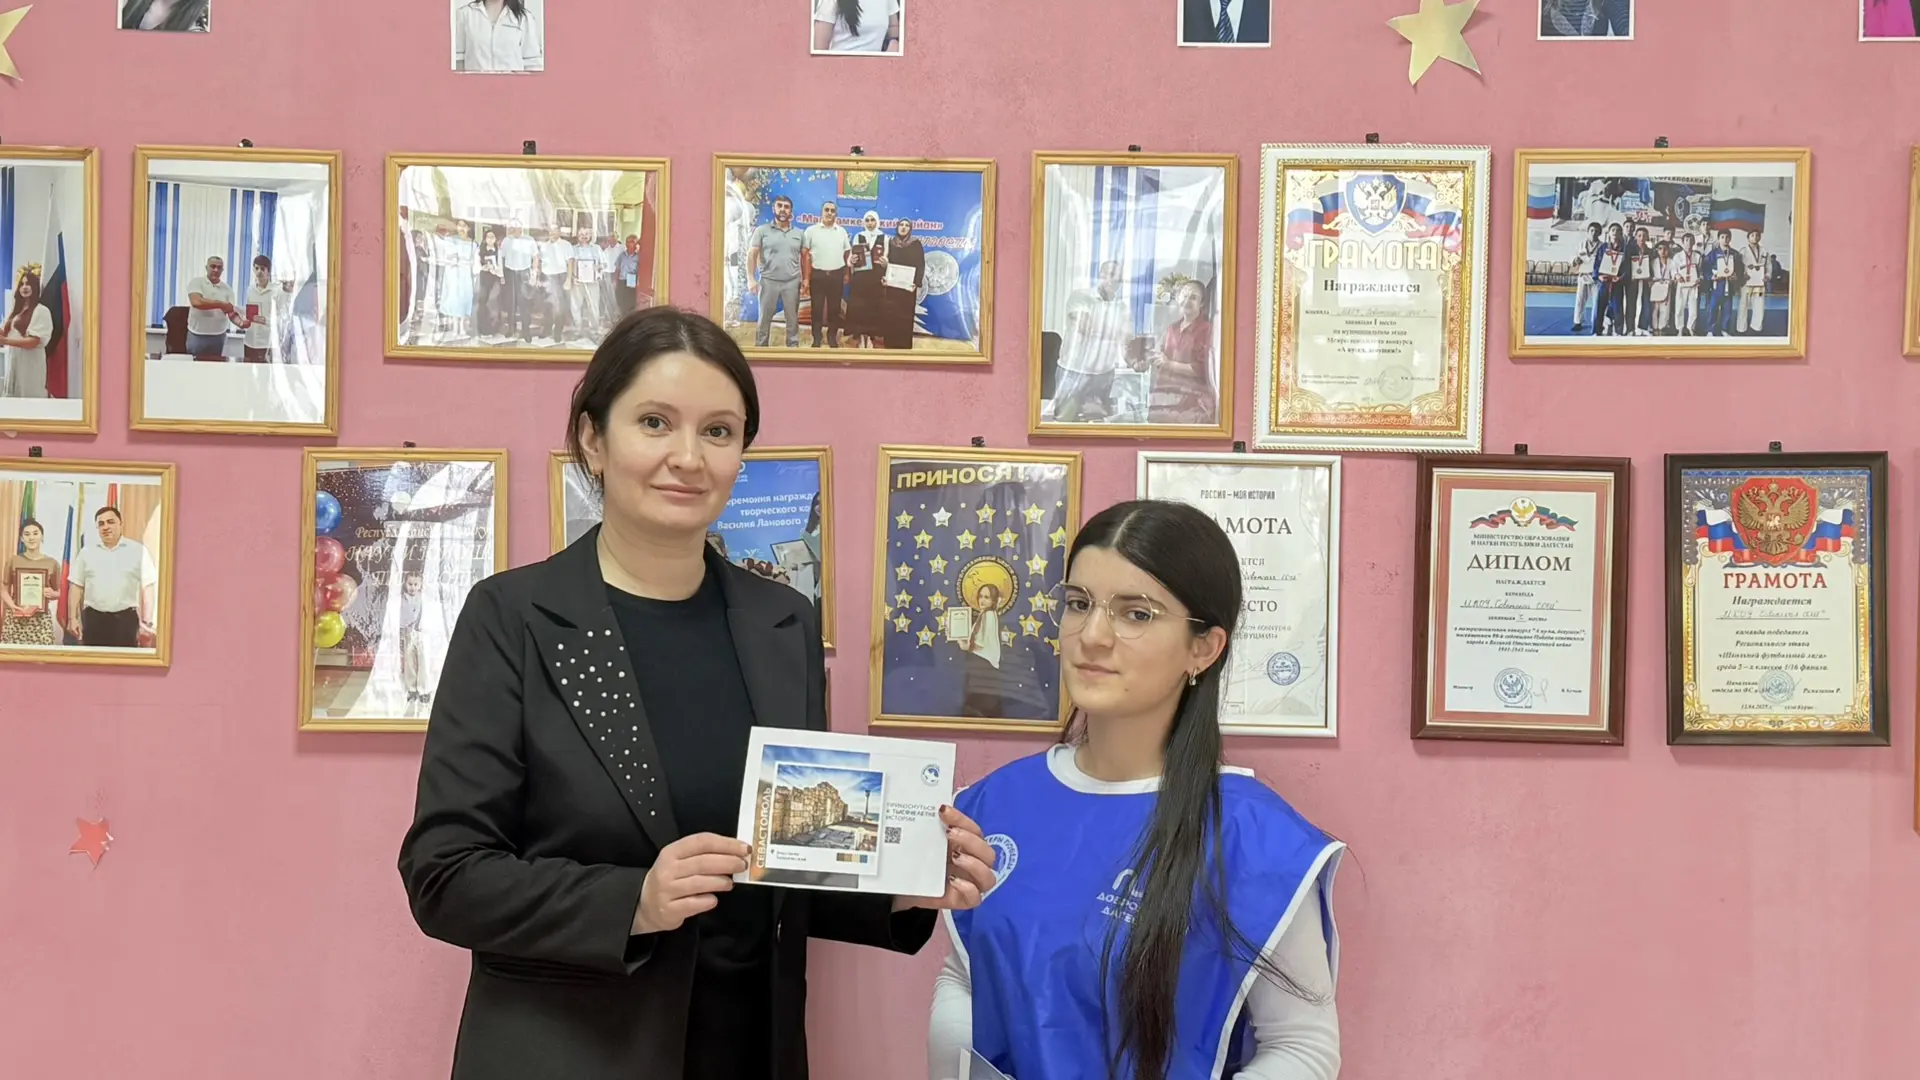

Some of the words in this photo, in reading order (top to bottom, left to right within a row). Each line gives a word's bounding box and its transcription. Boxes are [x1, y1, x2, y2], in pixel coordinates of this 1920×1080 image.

[1308, 239, 1438, 271] ГРАМОТА
[1324, 279, 1420, 295] Награждается
[1200, 489, 1226, 499] РОССИЯ
[1233, 490, 1247, 500] МОЯ
[1248, 491, 1276, 500] ИСТОРИЯ
[740, 506, 797, 517] творческого
[717, 521, 756, 530] Василия
[757, 518, 802, 528] Ланового
[1467, 554, 1572, 572] ДИПЛОМ
[1723, 573, 1828, 589] ГРАМОТА
[1732, 596, 1812, 607] Награждается
[756, 787, 772, 868] СЕВАСТОПОЛЬ
